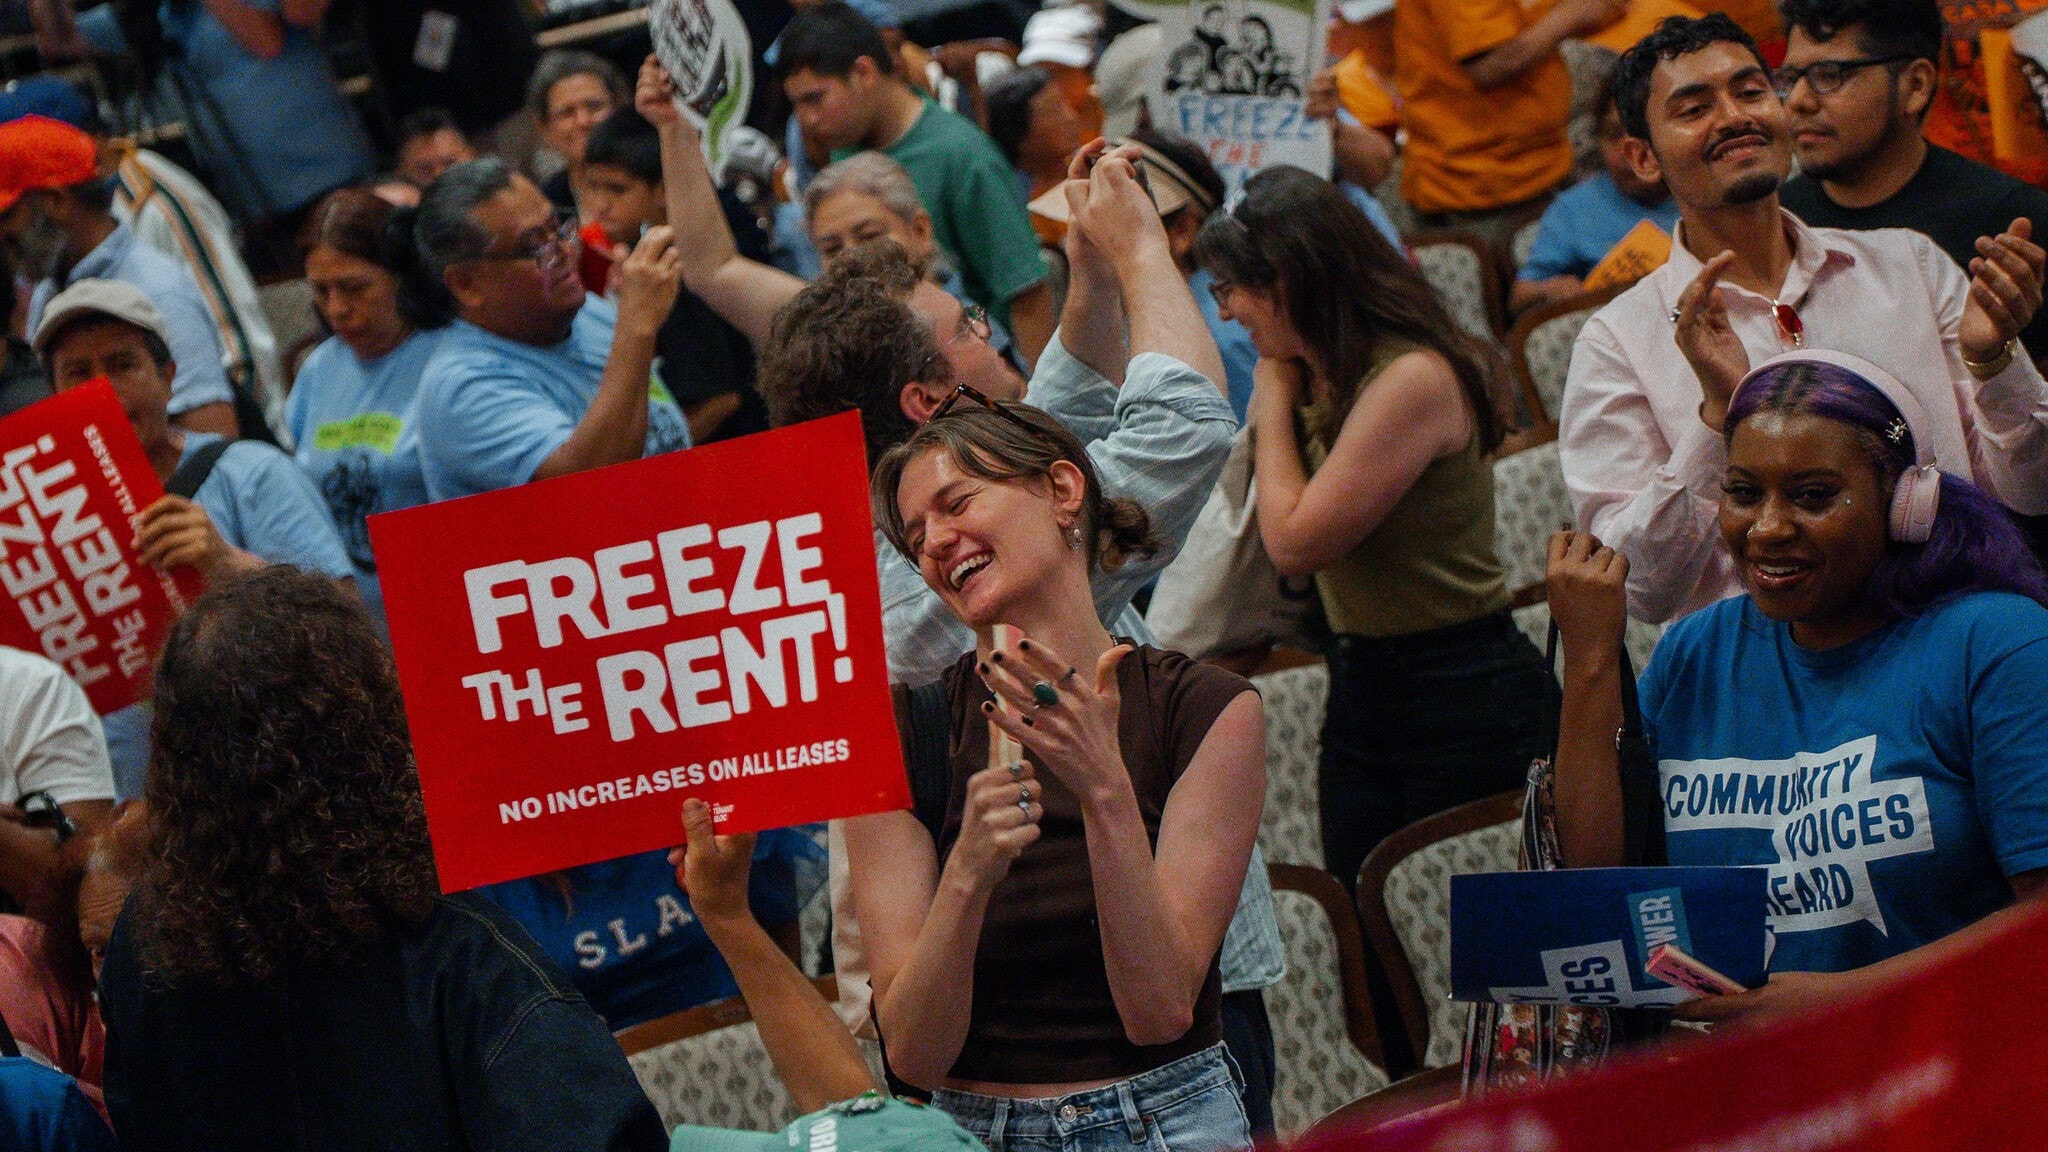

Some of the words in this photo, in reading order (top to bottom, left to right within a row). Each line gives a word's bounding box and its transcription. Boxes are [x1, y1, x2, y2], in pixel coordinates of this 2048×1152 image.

[3, 433, 142, 617] RENT!
[463, 512, 833, 654] FREEZE
[111, 608, 148, 679] THE
[461, 668, 590, 735] THE
[596, 591, 854, 743] RENT!
[498, 796, 542, 824] NO
[546, 763, 705, 814] INCREASES
[708, 757, 738, 782] ON
[741, 752, 774, 777] ALL
[776, 738, 851, 771] LEASES
[1665, 753, 1863, 819] COMMUNITY
[1785, 793, 1915, 862] VOICES
[1639, 896, 1678, 957] WER
